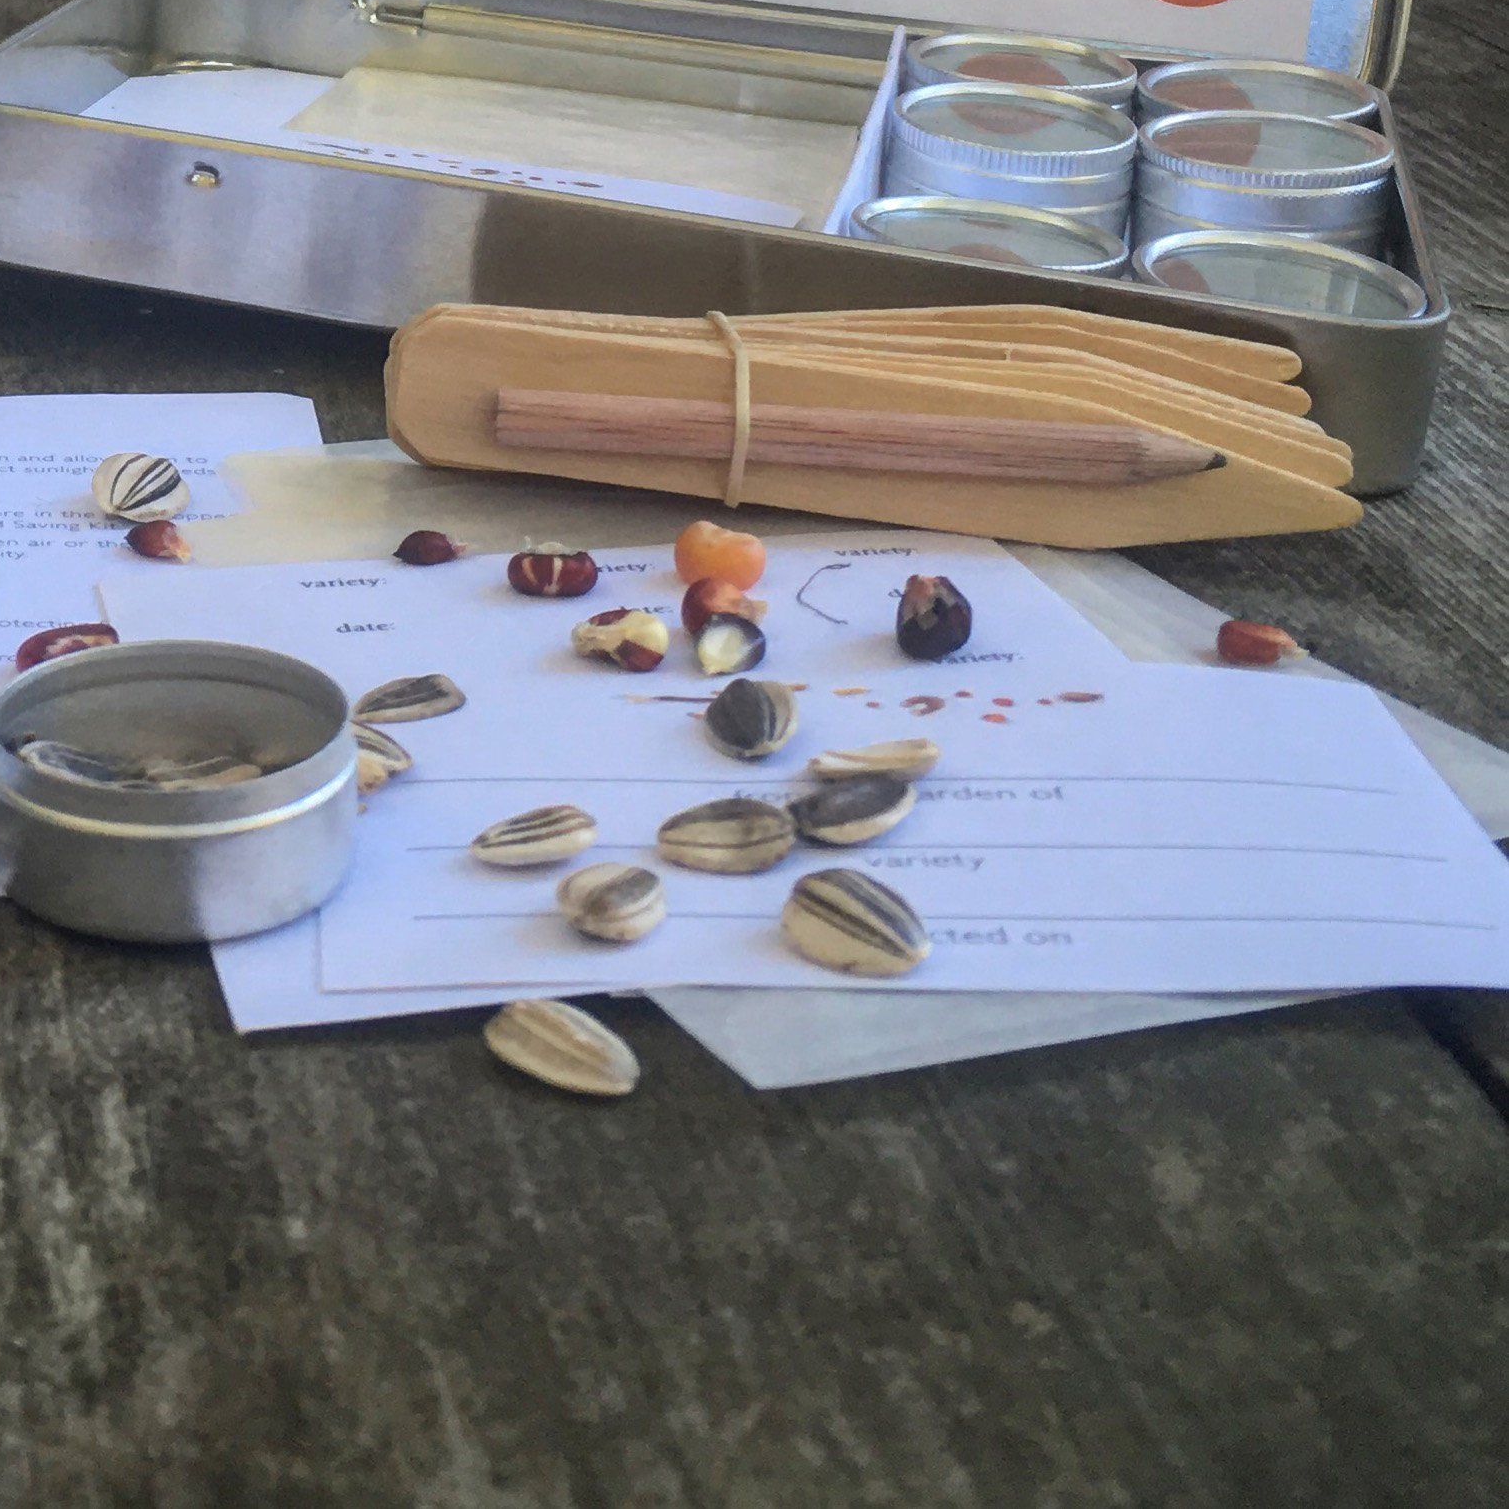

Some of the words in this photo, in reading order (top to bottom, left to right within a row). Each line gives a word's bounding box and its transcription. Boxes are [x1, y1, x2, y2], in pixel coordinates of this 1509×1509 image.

[301, 577, 387, 590] variety:
[336, 620, 395, 634] date:
[1030, 787, 1064, 800] of
[867, 854, 986, 871] variety
[1023, 933, 1073, 945] on
